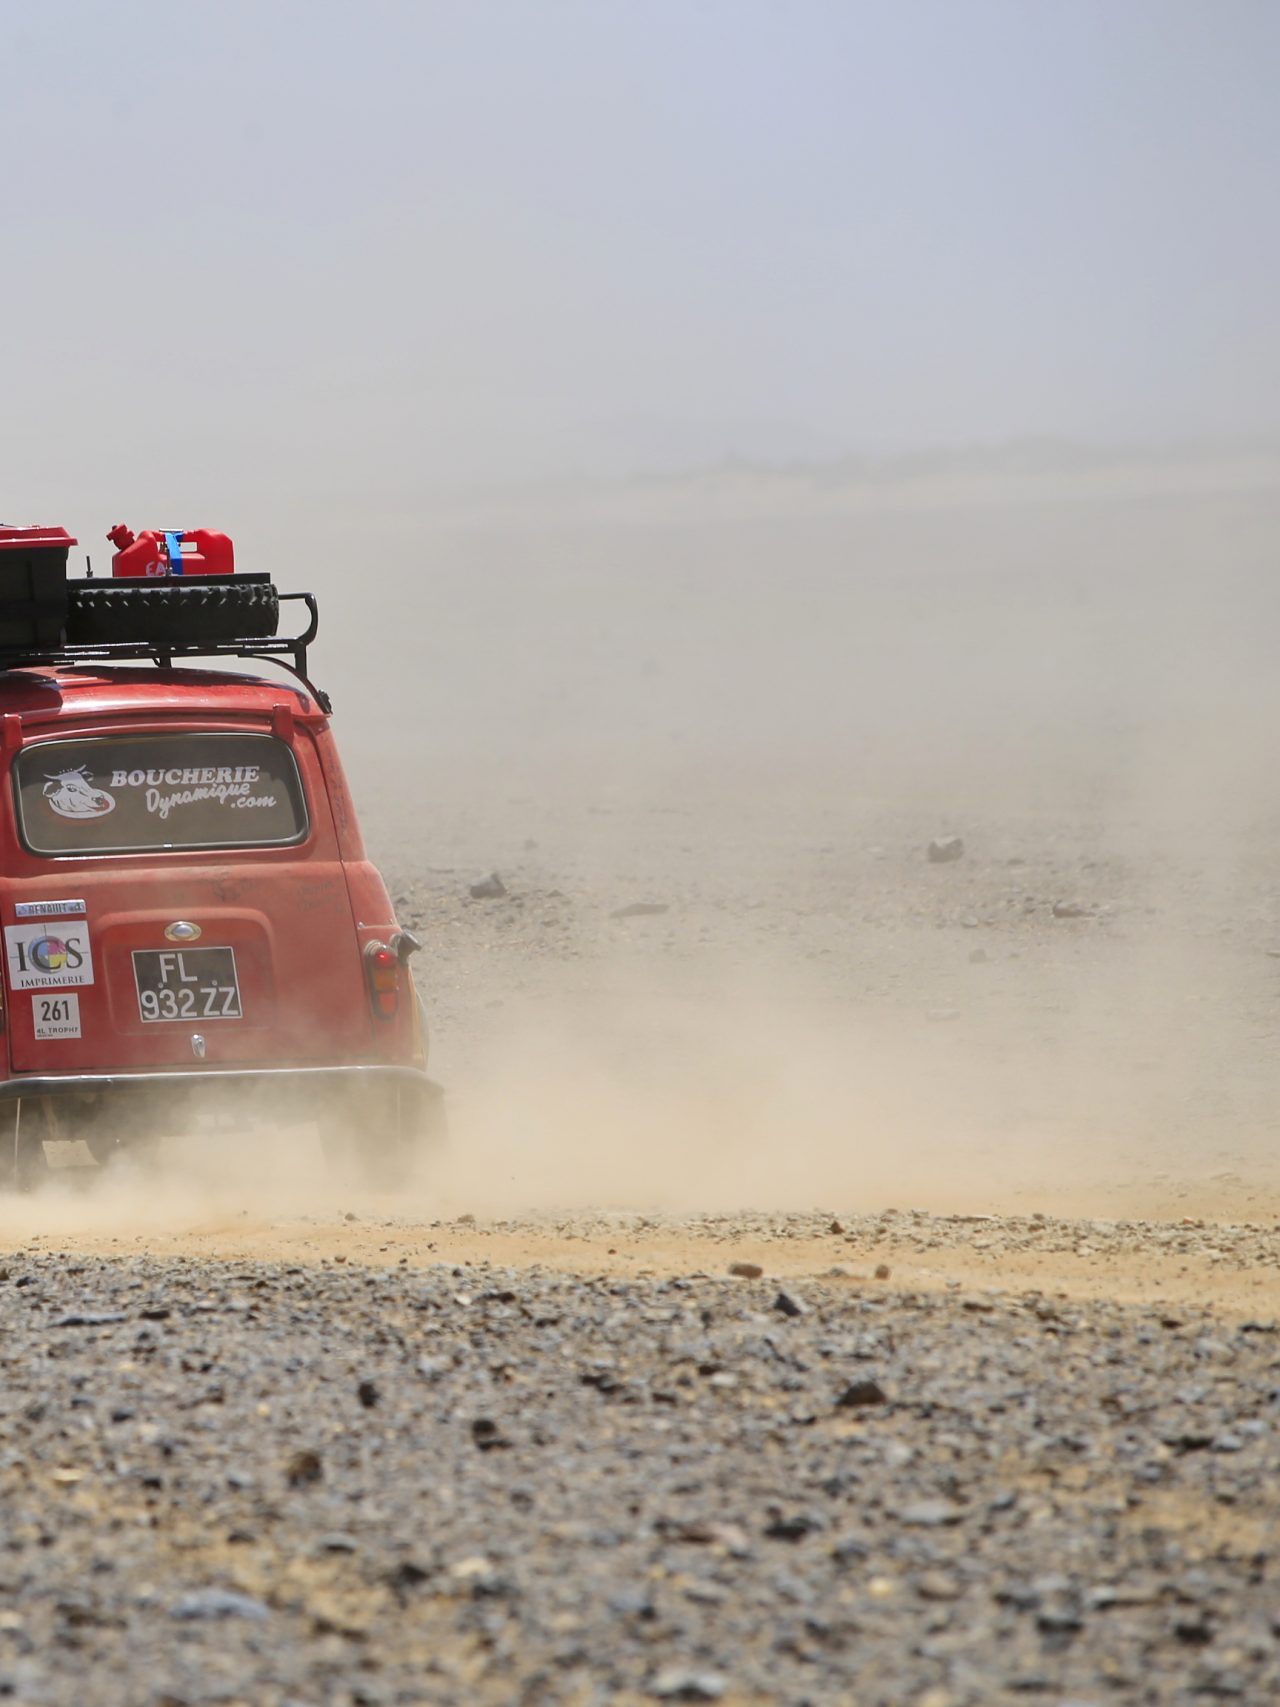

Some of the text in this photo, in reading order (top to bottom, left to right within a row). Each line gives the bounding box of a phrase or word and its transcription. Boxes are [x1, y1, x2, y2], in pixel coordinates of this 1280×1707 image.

[110, 766, 260, 787] BOUCHERIE
[146, 783, 251, 819] Dynamique
[231, 799, 276, 808] .com
[15, 938, 83, 973] ICS
[159, 953, 198, 983] FL
[21, 975, 85, 988] IMPRIMERIE
[41, 1000, 70, 1021] 261
[141, 987, 239, 1020] 932 ZZ
